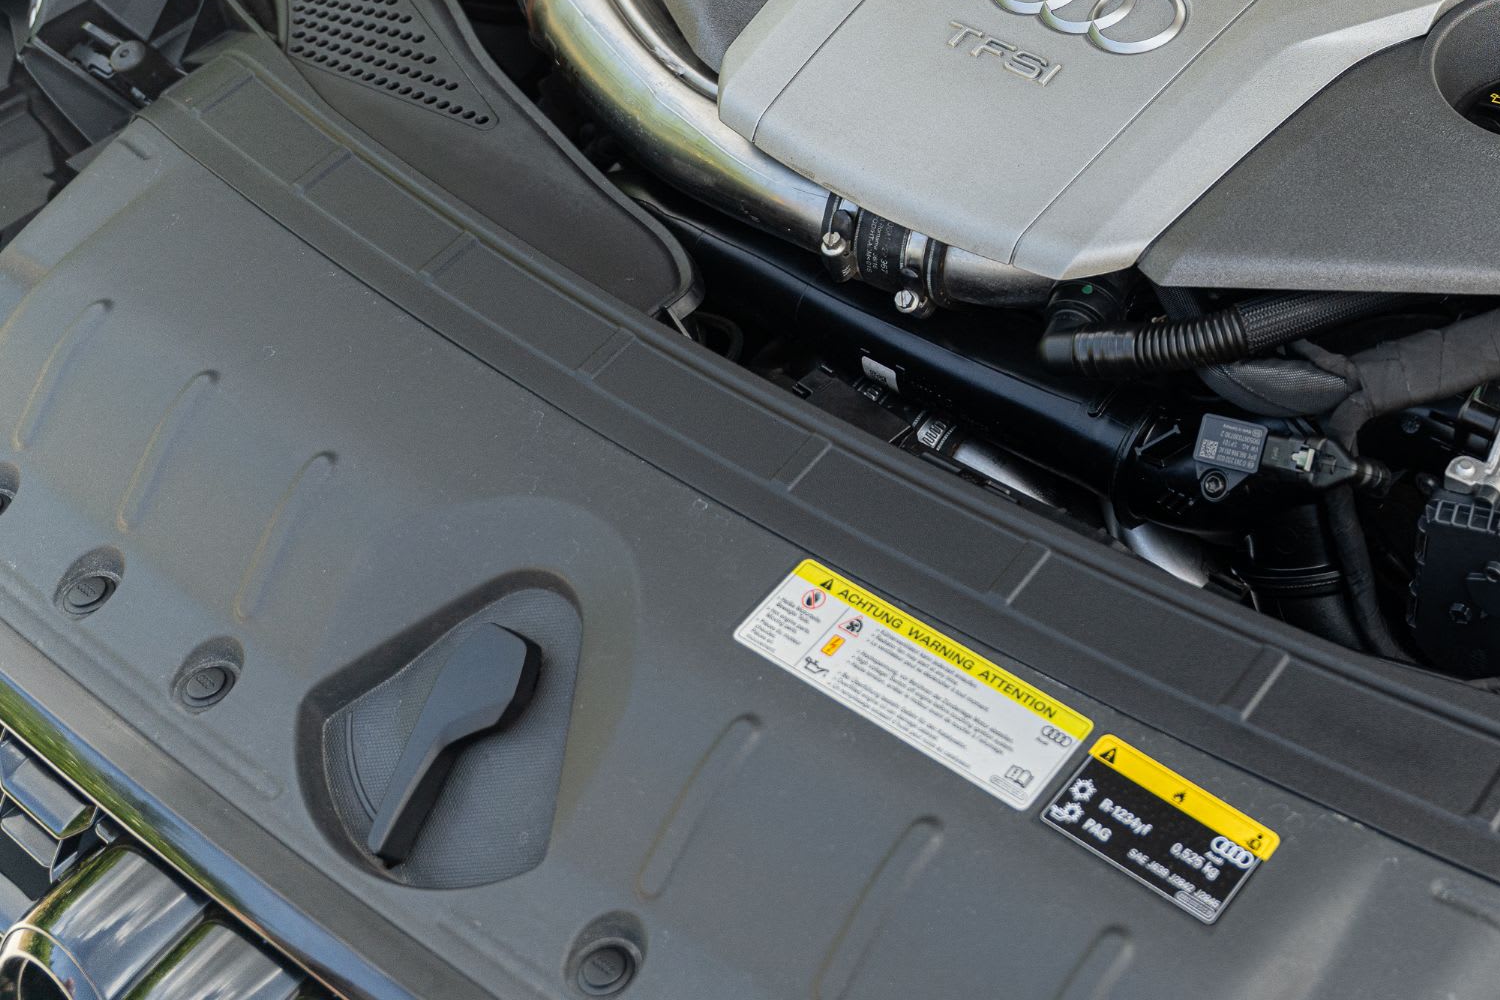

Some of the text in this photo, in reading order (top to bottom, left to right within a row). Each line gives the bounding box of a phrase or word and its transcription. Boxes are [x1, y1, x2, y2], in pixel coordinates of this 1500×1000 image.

[947, 20, 1063, 88] TFSI
[837, 590, 904, 629] ACHTUNG
[907, 627, 976, 670] WARNING
[977, 671, 1058, 718] ATTENTION
[1081, 816, 1114, 843] PAG
[1126, 847, 1149, 865] SAE
[1167, 840, 1206, 871] 0,525
[1198, 860, 1222, 882] kg
